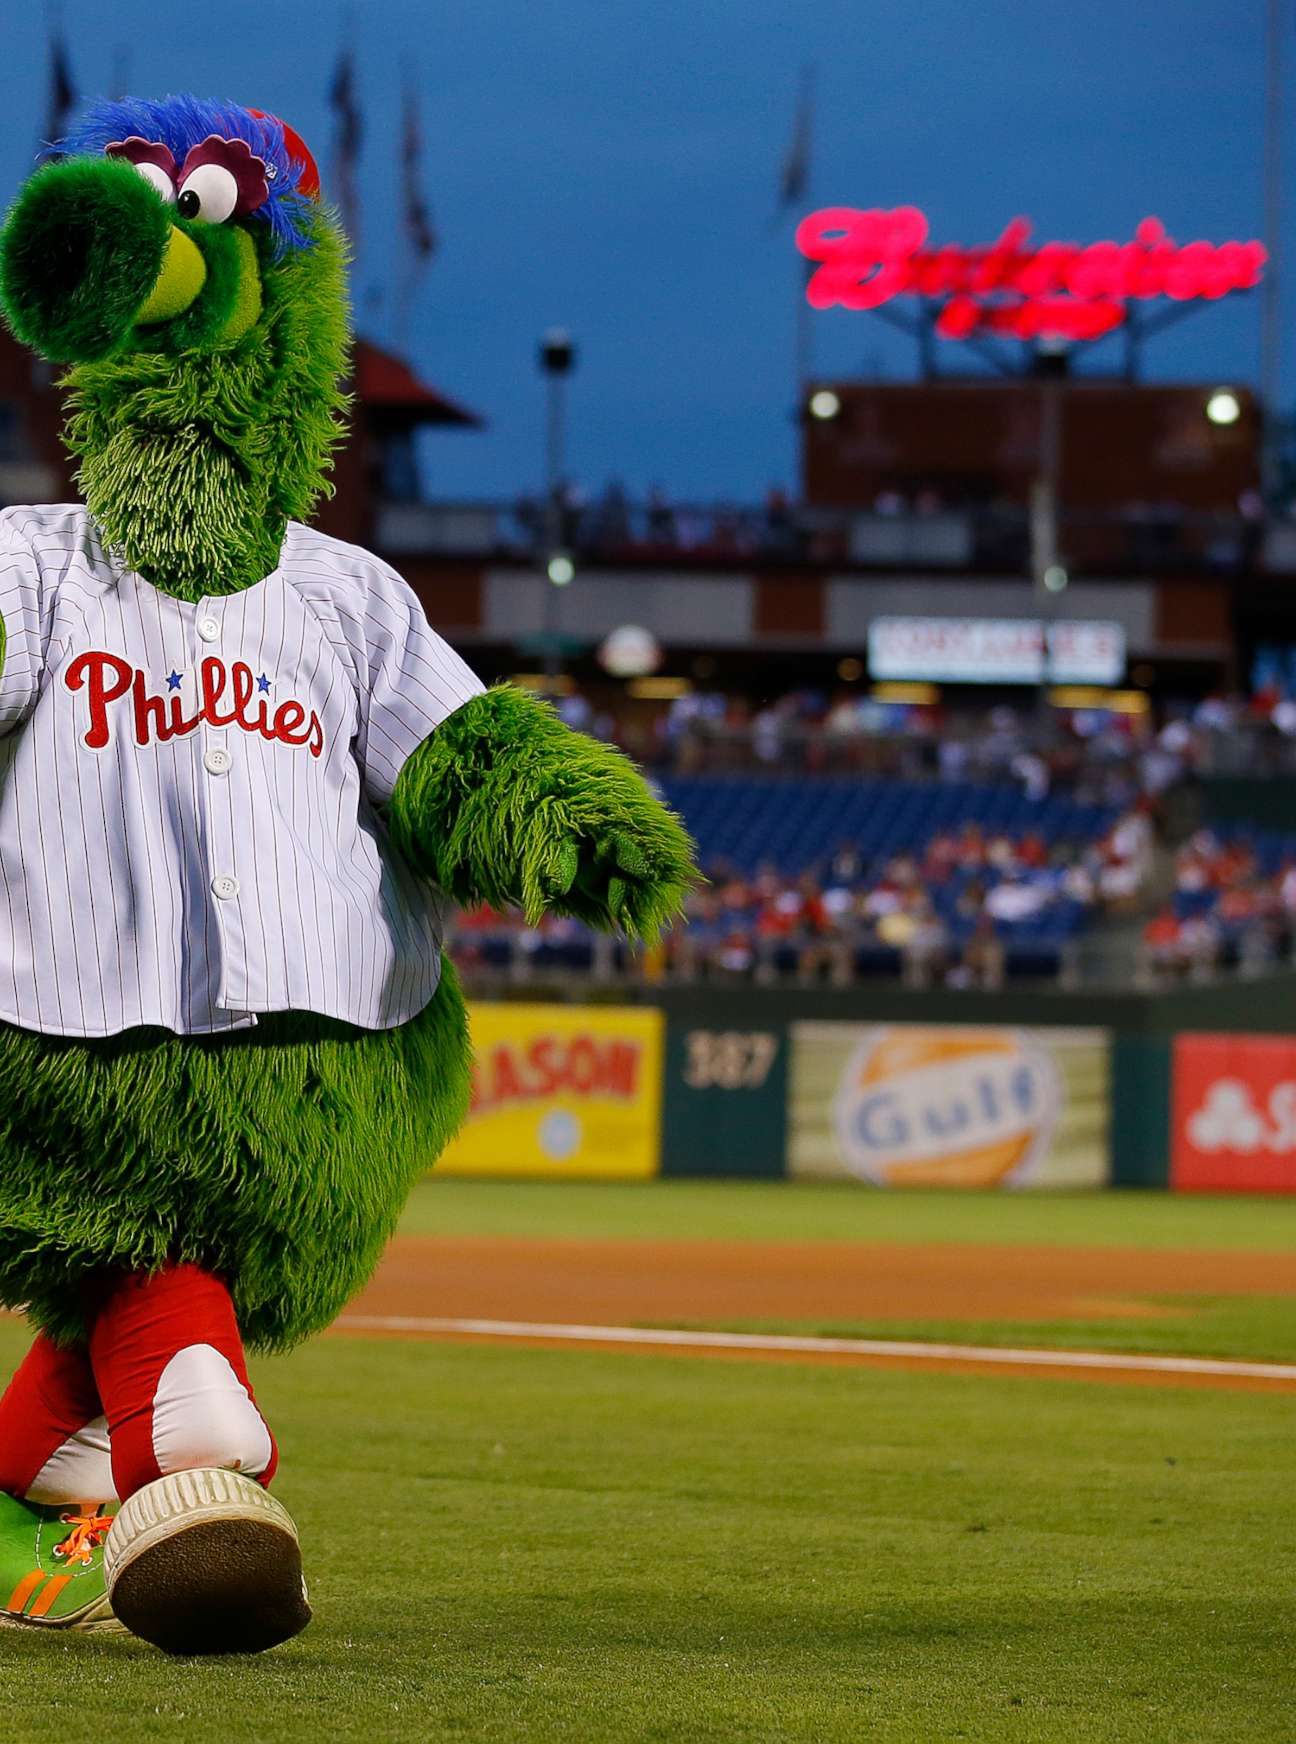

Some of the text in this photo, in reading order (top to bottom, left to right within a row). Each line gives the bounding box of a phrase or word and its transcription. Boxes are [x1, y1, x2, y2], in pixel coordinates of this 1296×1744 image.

[65, 651, 323, 758] Phillies
[470, 1034, 641, 1112] ASON
[854, 1066, 1036, 1148] Gulf
